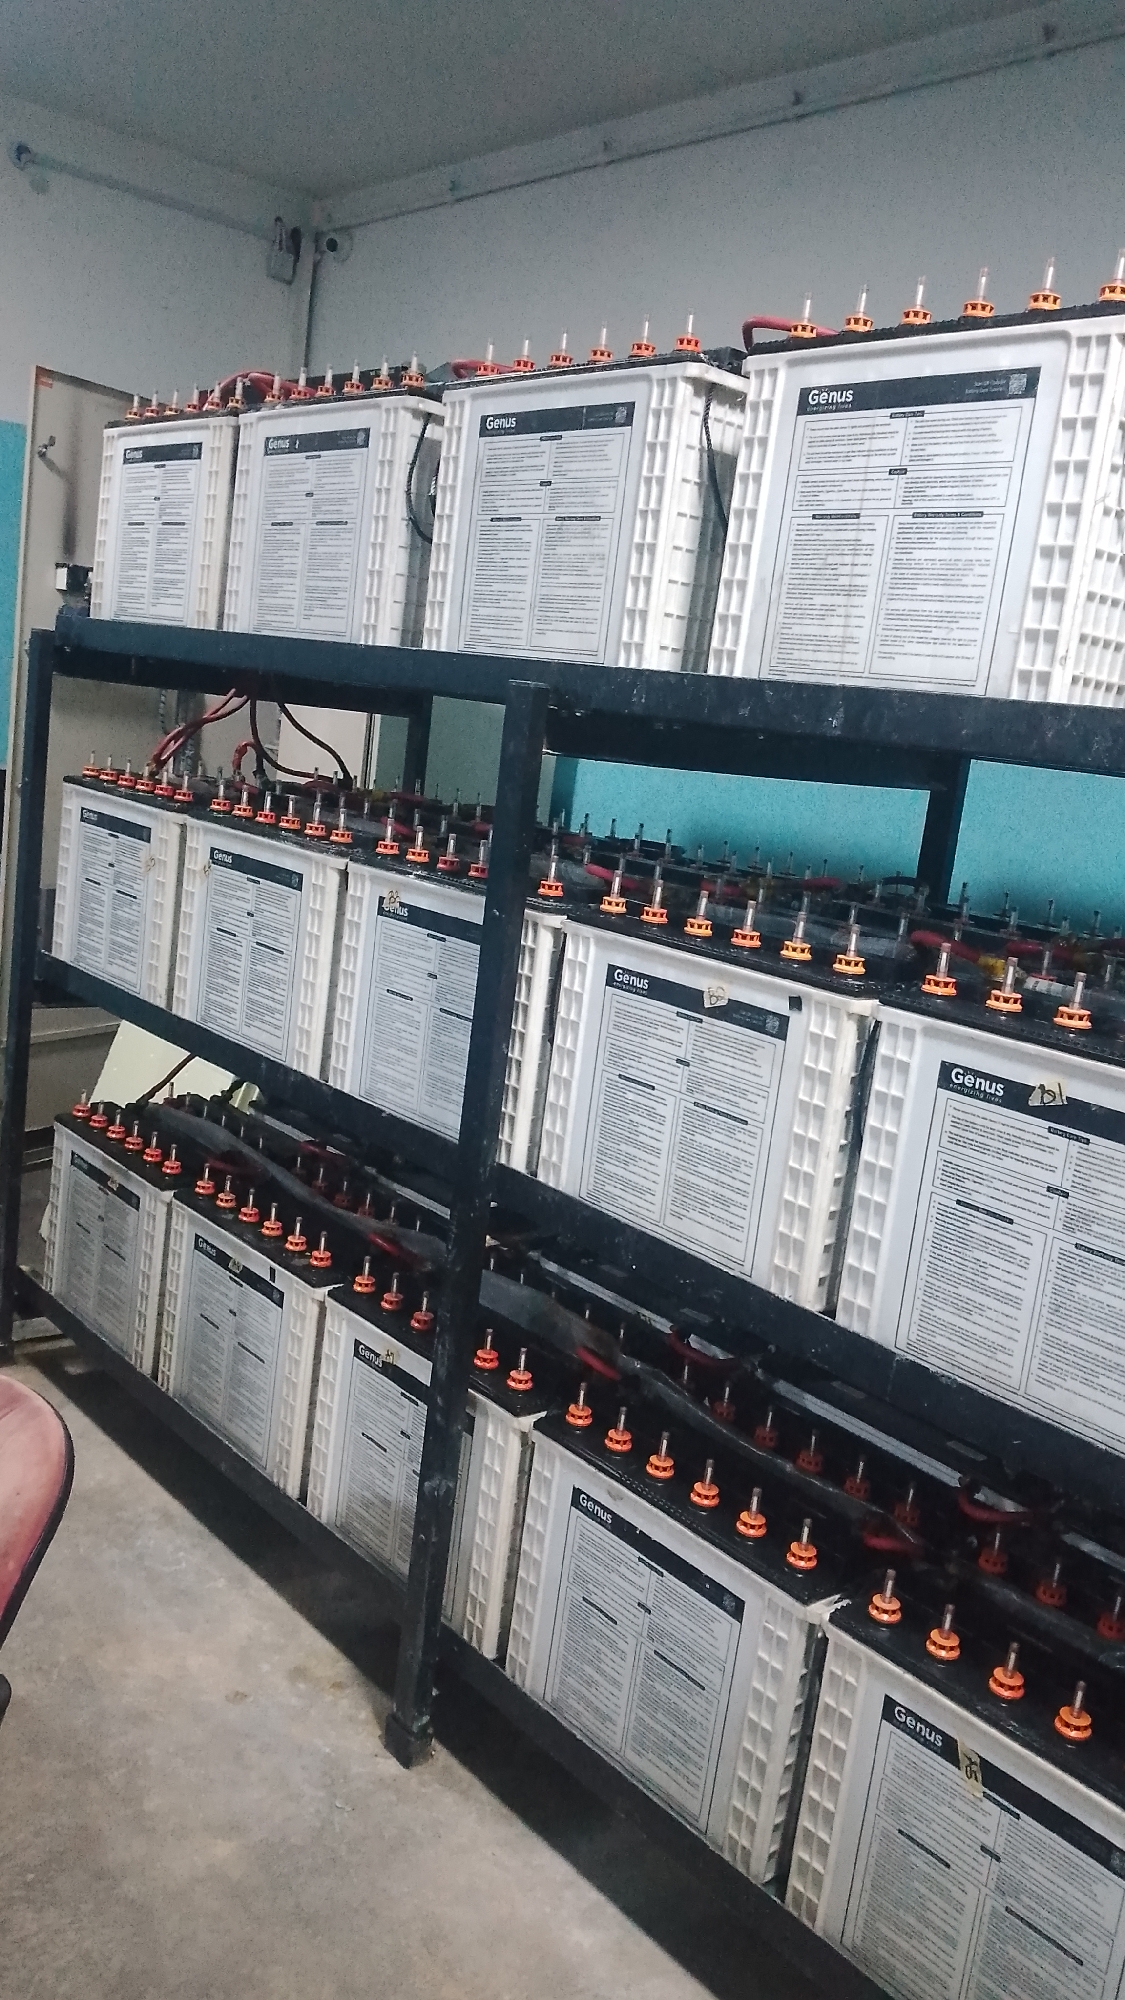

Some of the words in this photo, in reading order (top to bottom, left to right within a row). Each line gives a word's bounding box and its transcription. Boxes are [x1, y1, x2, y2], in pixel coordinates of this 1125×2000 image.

[808, 388, 854, 405] Genus
[486, 416, 517, 430] Genus
[213, 850, 233, 864] Genus
[614, 968, 650, 990] Genus
[951, 1067, 1004, 1097] Genus
[358, 1344, 383, 1368] Genus
[580, 1494, 612, 1524] Genus
[894, 1706, 943, 1747] Genus
